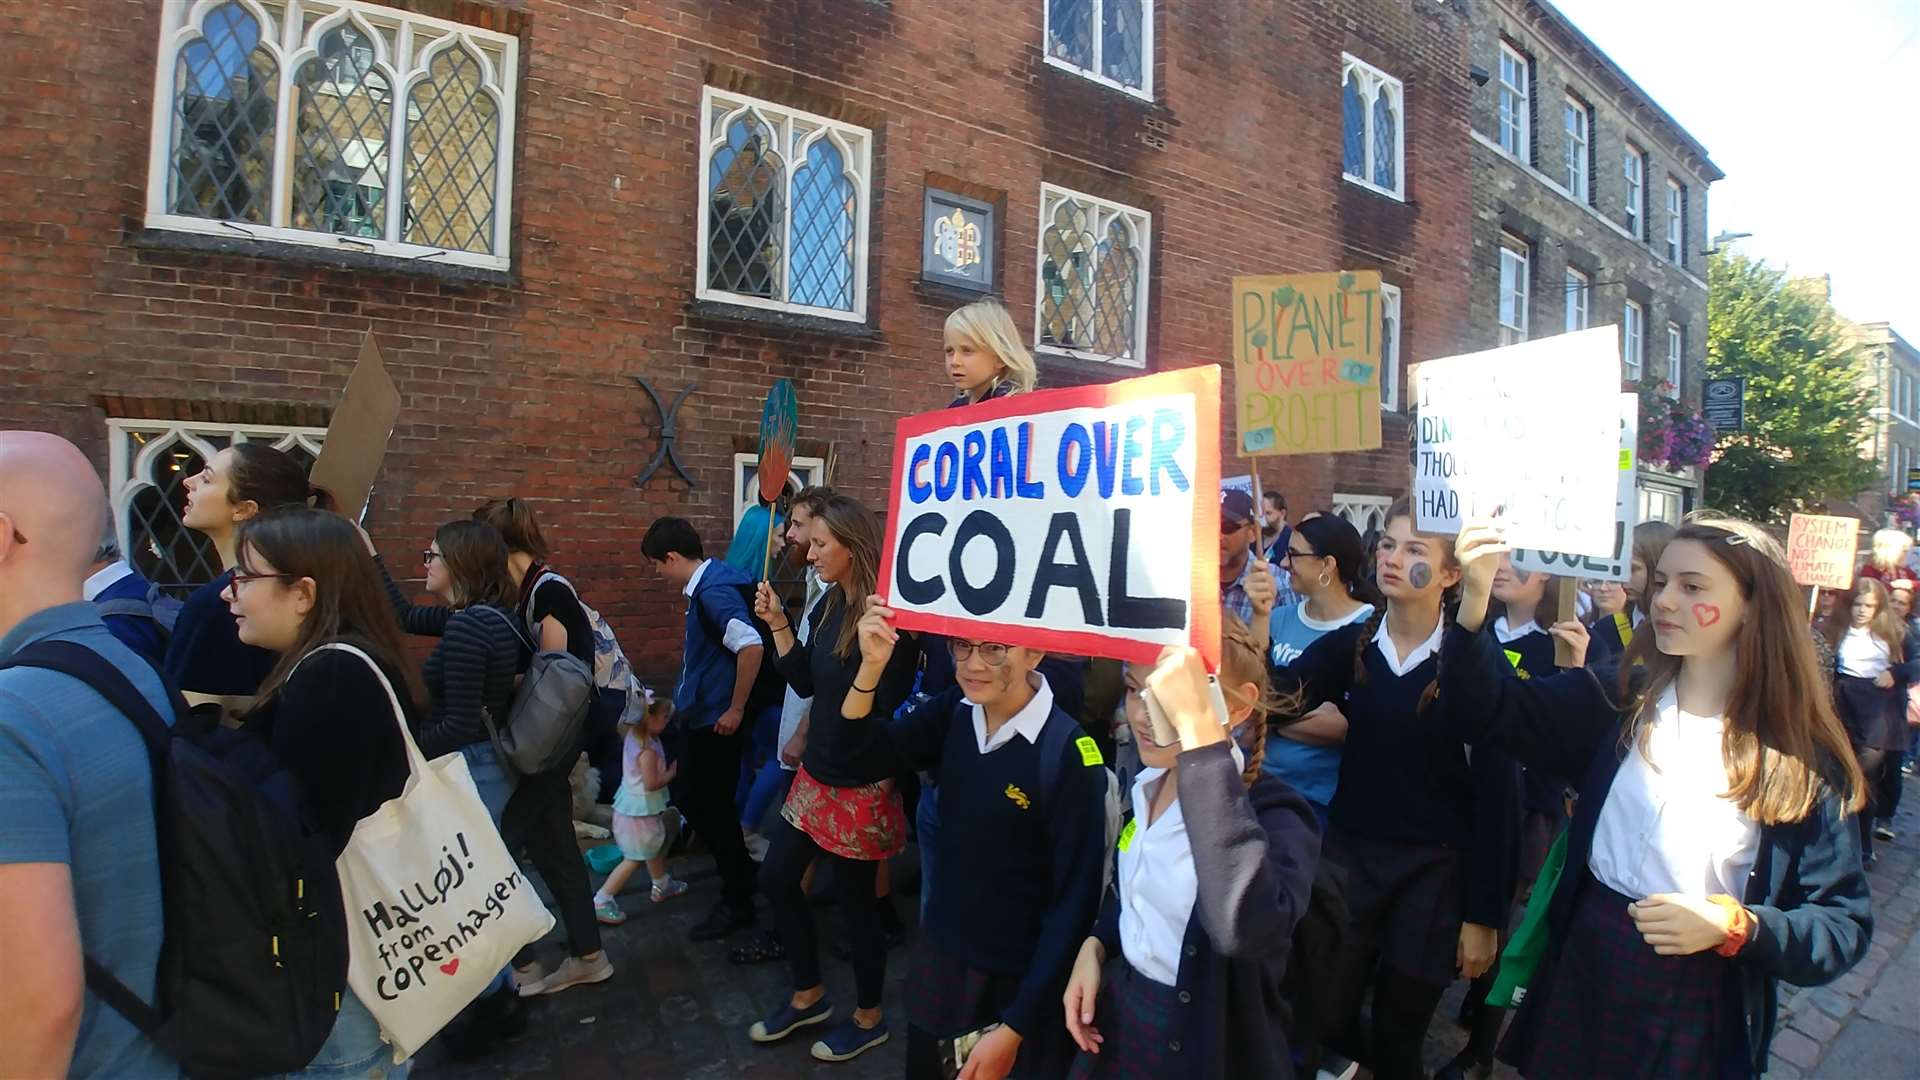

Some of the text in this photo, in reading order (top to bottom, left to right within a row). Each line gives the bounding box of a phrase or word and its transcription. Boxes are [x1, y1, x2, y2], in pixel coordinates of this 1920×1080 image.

[1242, 289, 1378, 364] PLANET
[1255, 359, 1341, 392] OVER
[1246, 387, 1378, 449] PROFIT
[908, 407, 1191, 504] CORAL OVER
[1421, 490, 1459, 519] HAD
[1794, 516, 1848, 535] SYSTEM
[1796, 533, 1852, 550] CHANGE
[896, 508, 1187, 630] COAL
[1791, 548, 1818, 561] NOT
[378, 924, 435, 971] from
